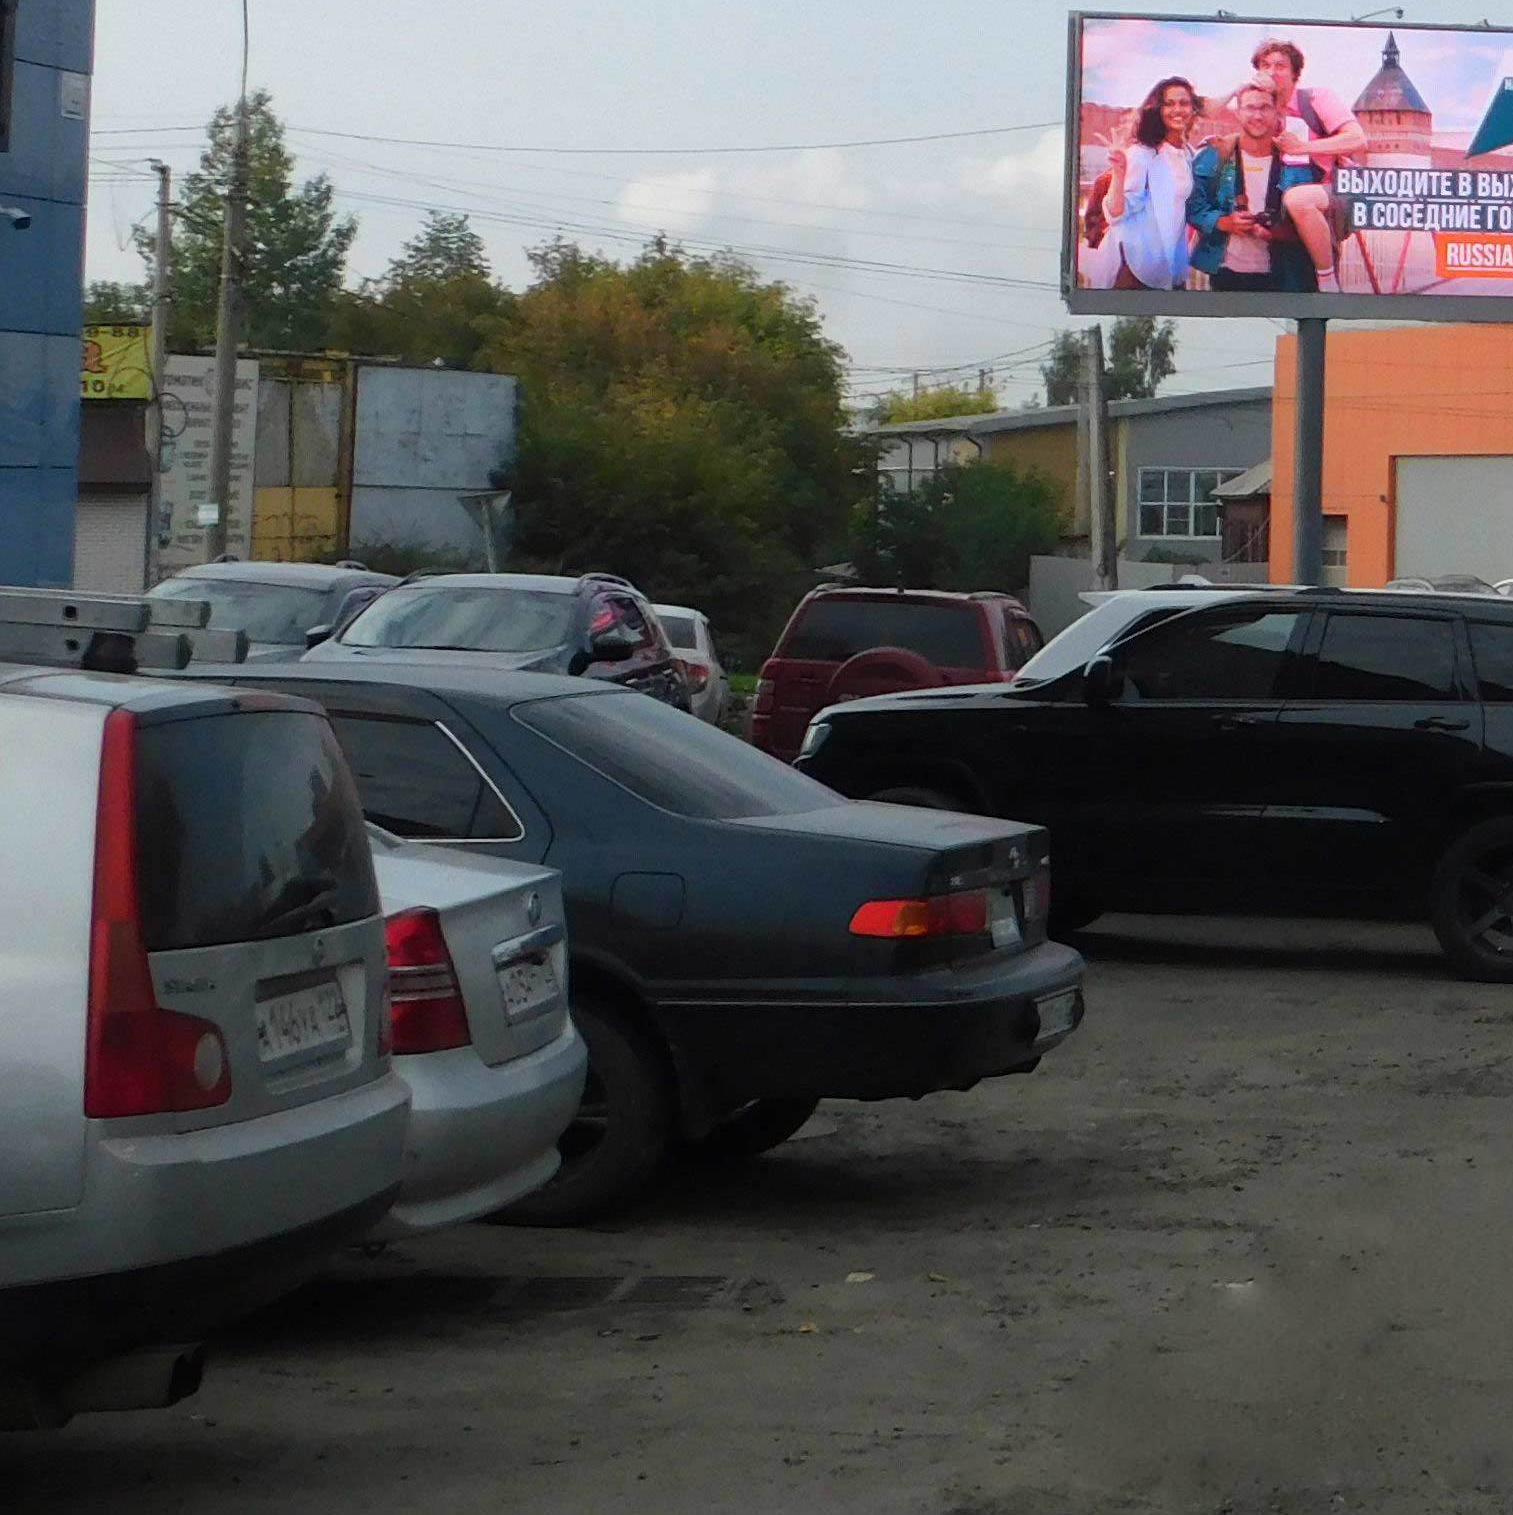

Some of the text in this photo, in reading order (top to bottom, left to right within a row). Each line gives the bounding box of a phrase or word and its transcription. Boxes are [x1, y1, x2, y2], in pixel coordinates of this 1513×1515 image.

[1337, 169, 1452, 198] ВЫХОДИТЕ
[1459, 172, 1472, 196] В
[1354, 202, 1367, 227] В
[1372, 202, 1482, 231] СОСЕДНИЕ
